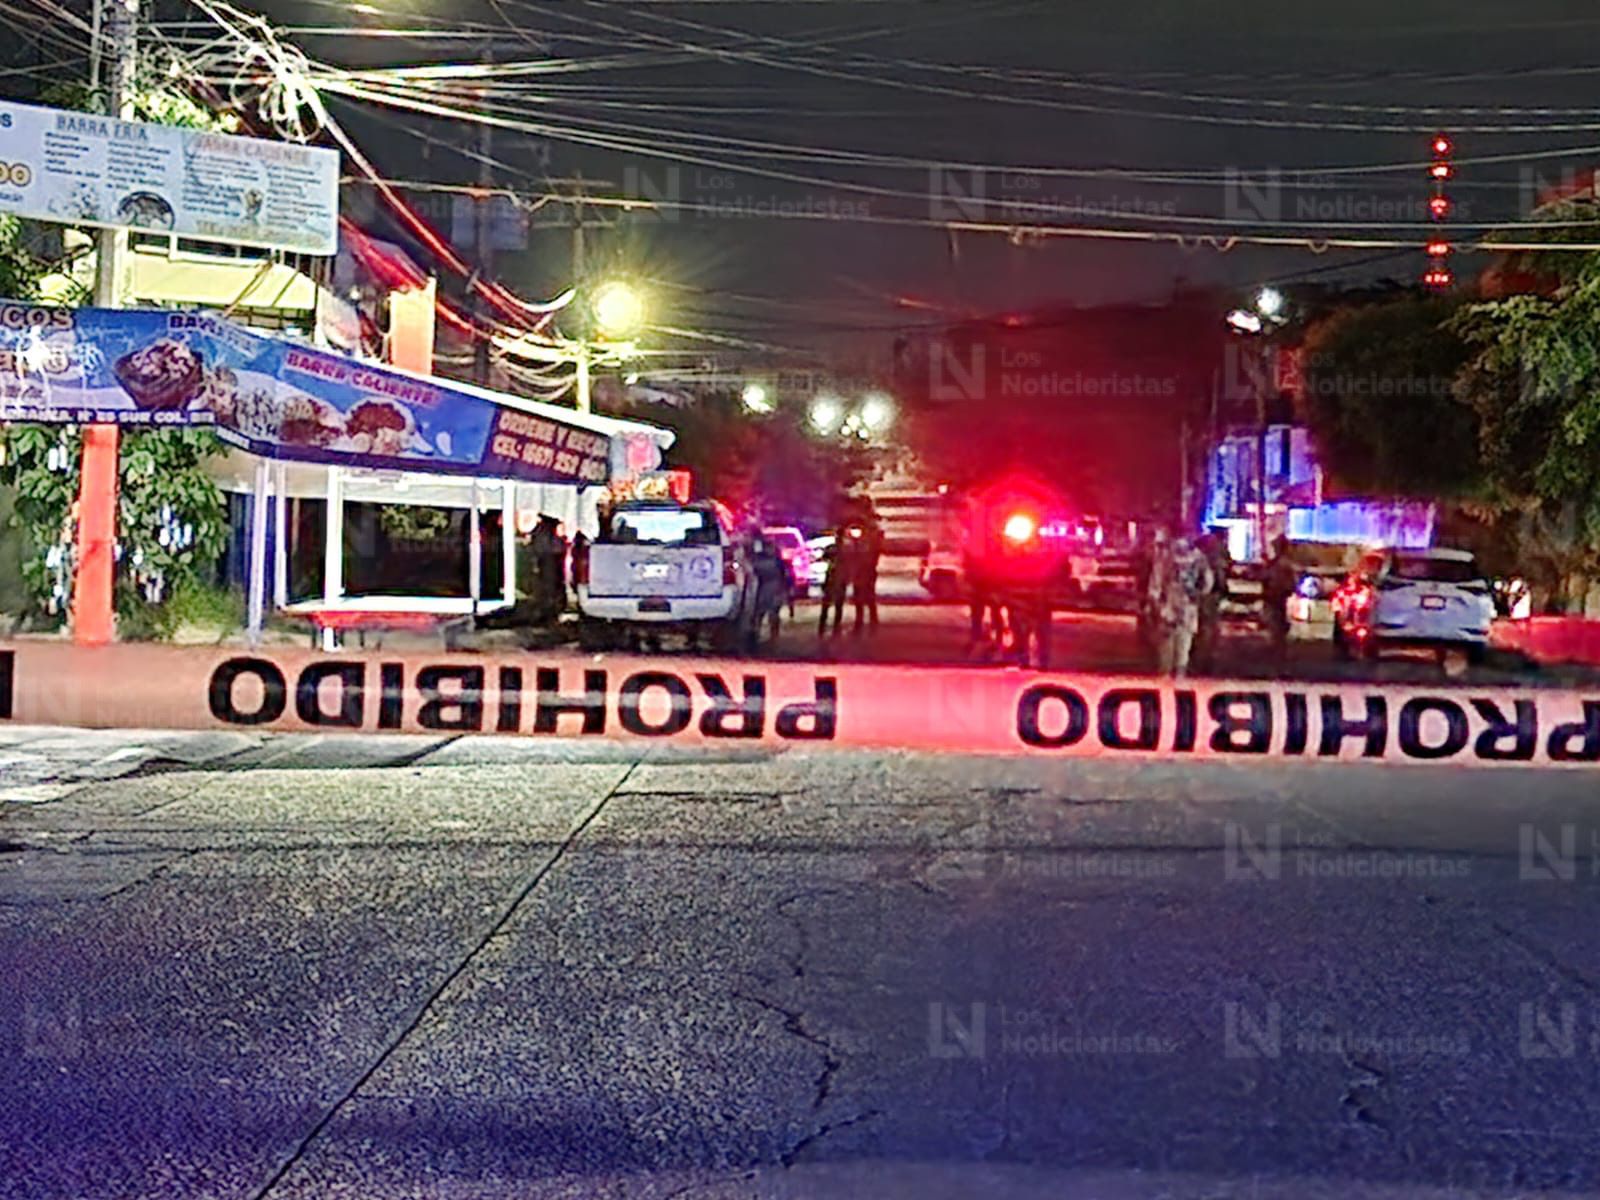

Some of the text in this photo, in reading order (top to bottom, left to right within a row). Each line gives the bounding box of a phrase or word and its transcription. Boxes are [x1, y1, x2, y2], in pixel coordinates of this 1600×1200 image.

[56, 114, 109, 139] BARRA
[287, 352, 436, 405] BARRA CALIENTE
[208, 655, 836, 740] PROHIBIDO
[1017, 683, 1600, 762] PROHIBIDO
